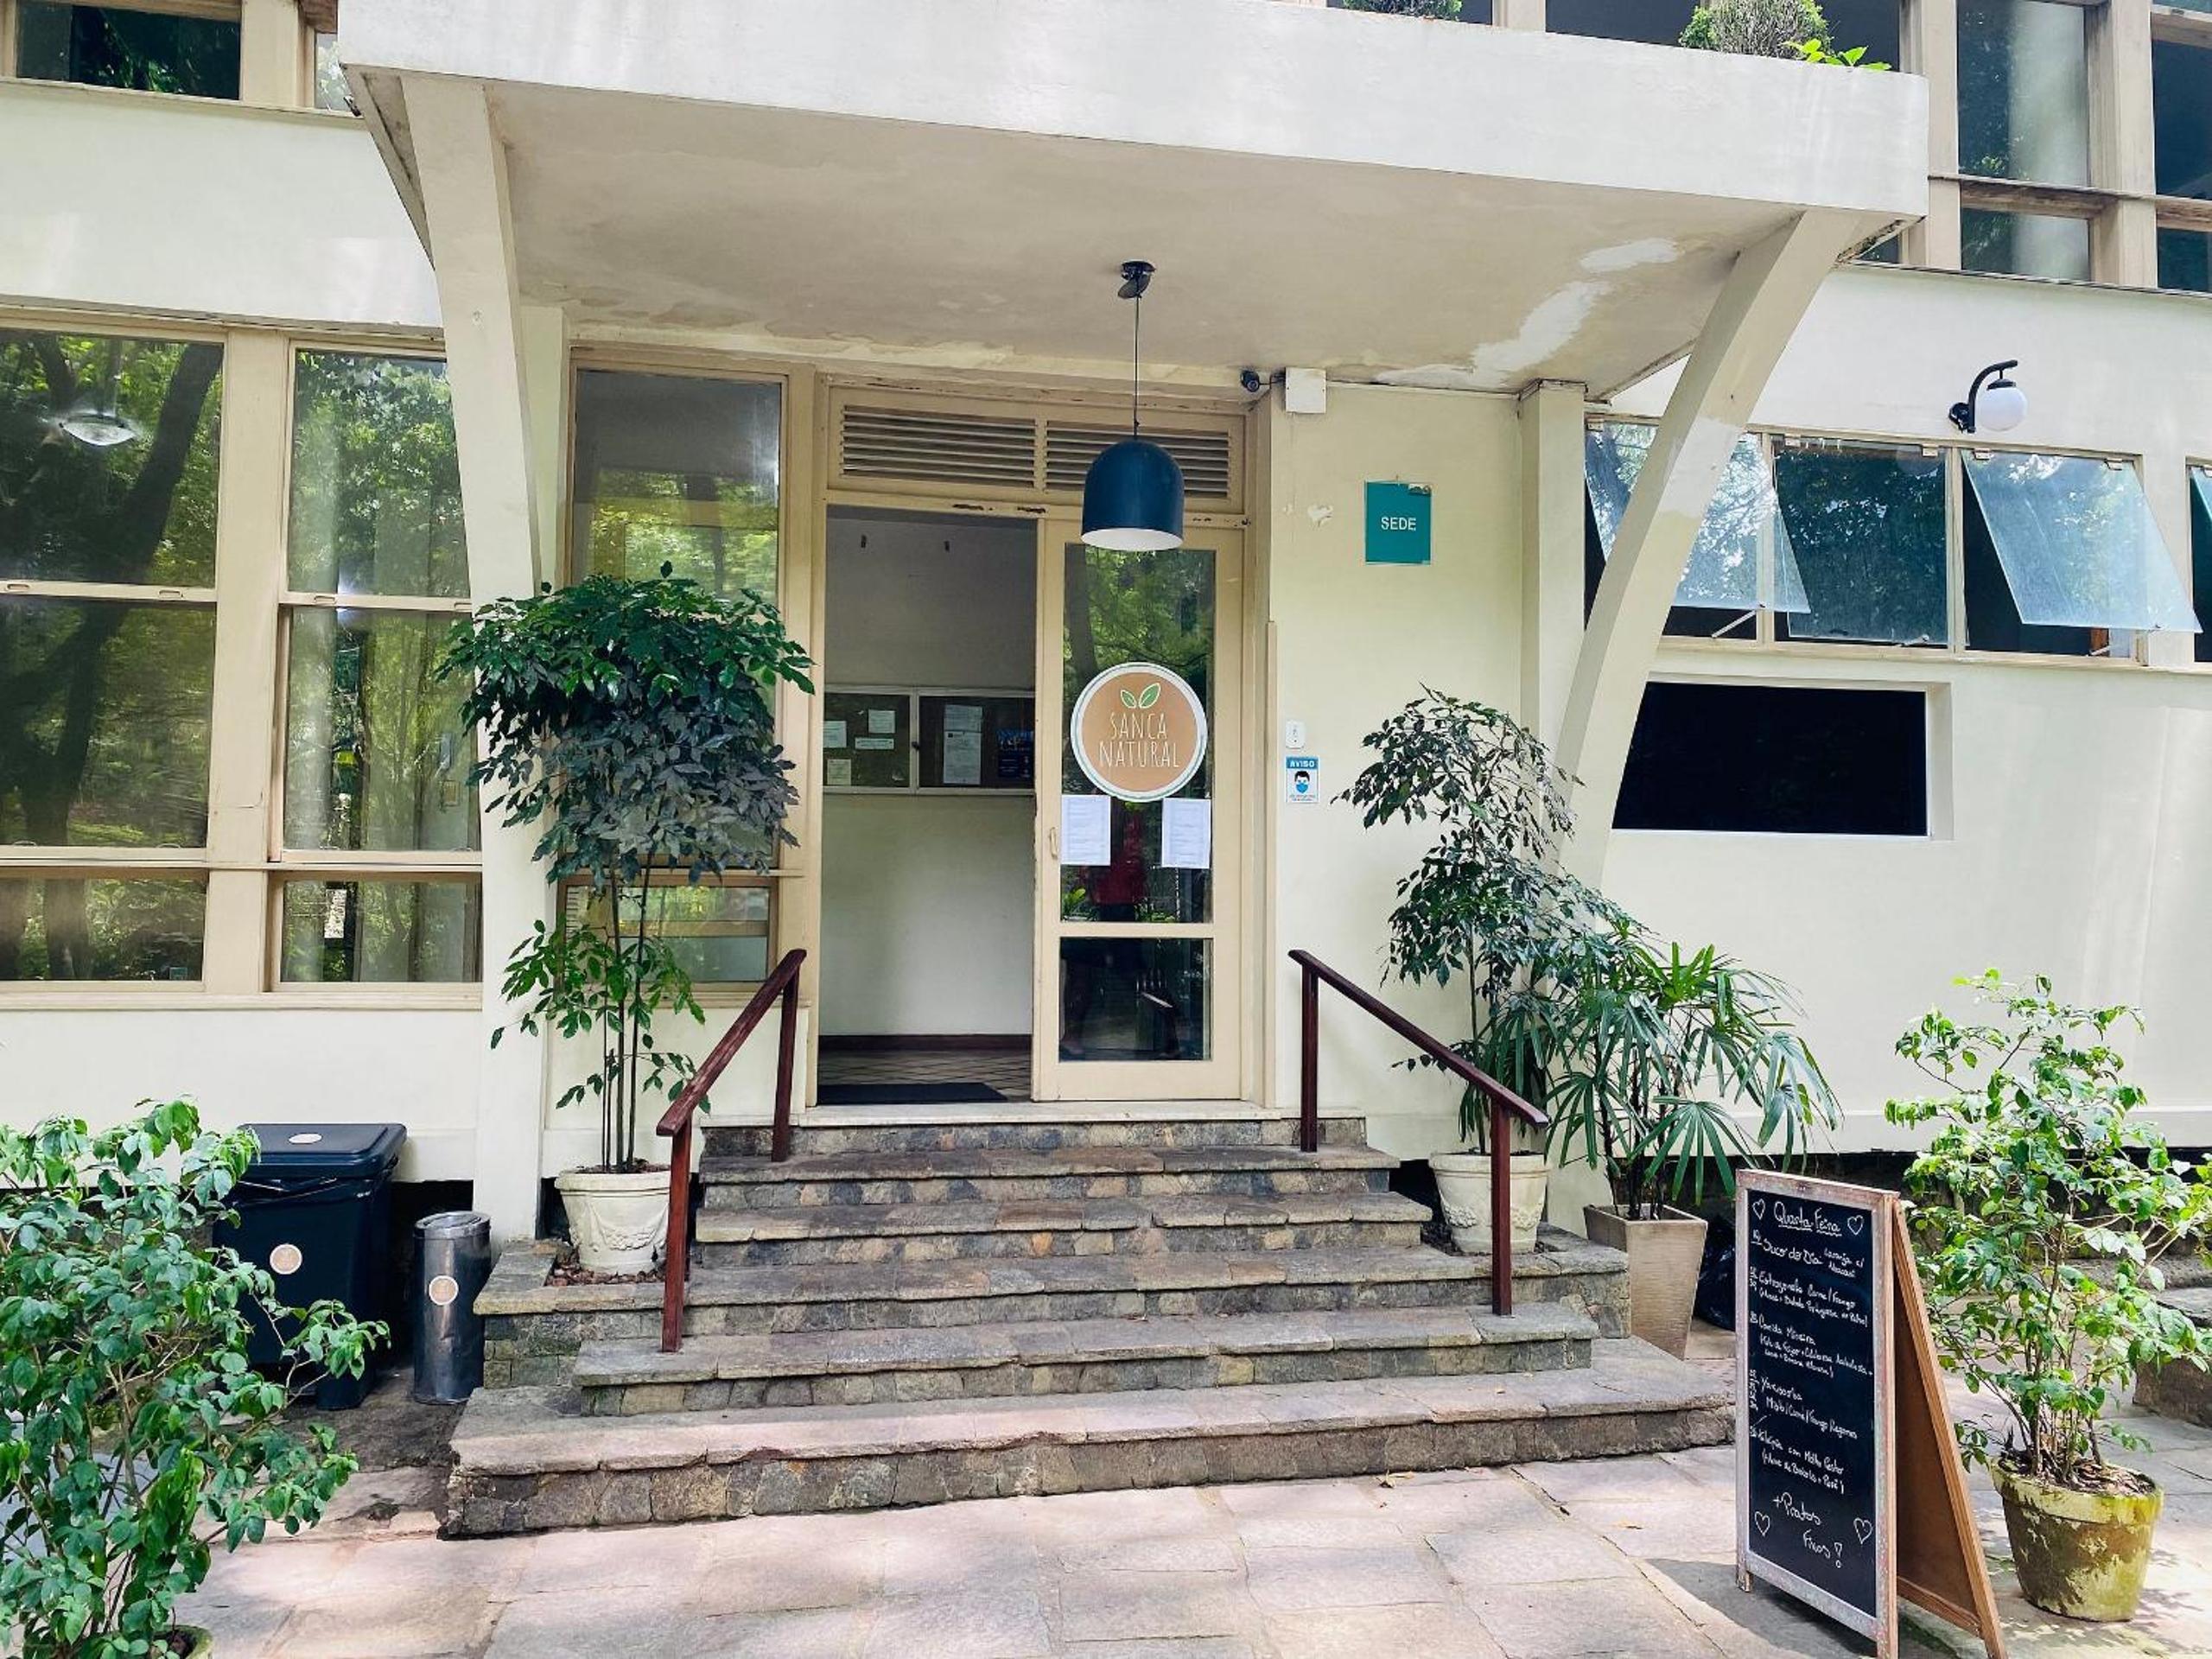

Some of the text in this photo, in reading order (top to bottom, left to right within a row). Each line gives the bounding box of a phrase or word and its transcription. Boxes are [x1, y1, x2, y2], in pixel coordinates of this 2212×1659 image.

[1381, 517, 1416, 531] SEDE
[1110, 712, 1167, 740] SANCA
[1099, 741, 1179, 767] NATURAL
[1764, 1238, 1788, 1257] Suco
[1789, 1247, 1802, 1261] do
